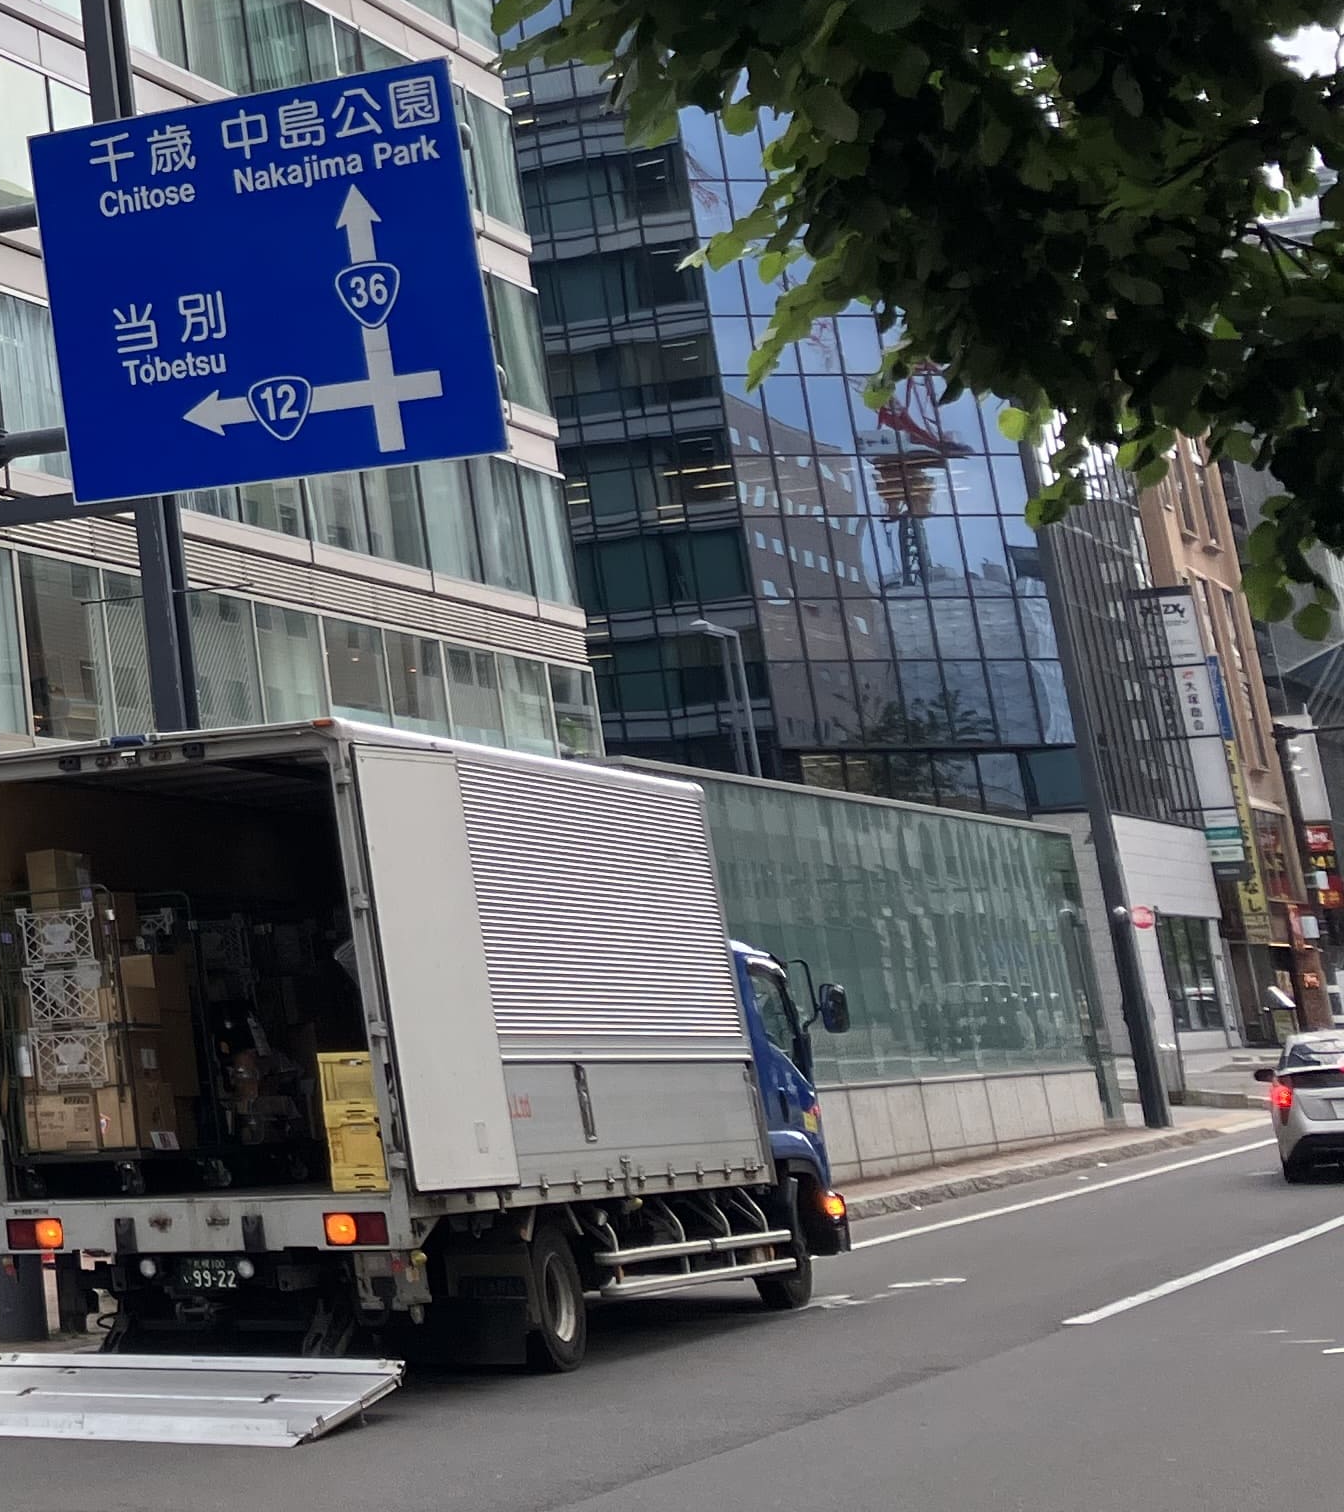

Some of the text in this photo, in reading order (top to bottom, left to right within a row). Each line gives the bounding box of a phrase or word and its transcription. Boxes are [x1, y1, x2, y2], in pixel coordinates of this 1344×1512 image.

[89, 75, 441, 183] 千歳 中島公園
[233, 135, 440, 194] Nakajima Park
[99, 182, 196, 217] Chitose
[349, 273, 389, 309] 36
[113, 290, 227, 355] 当別
[260, 384, 300, 422] 12
[193, 1270, 237, 1288] 99-22
